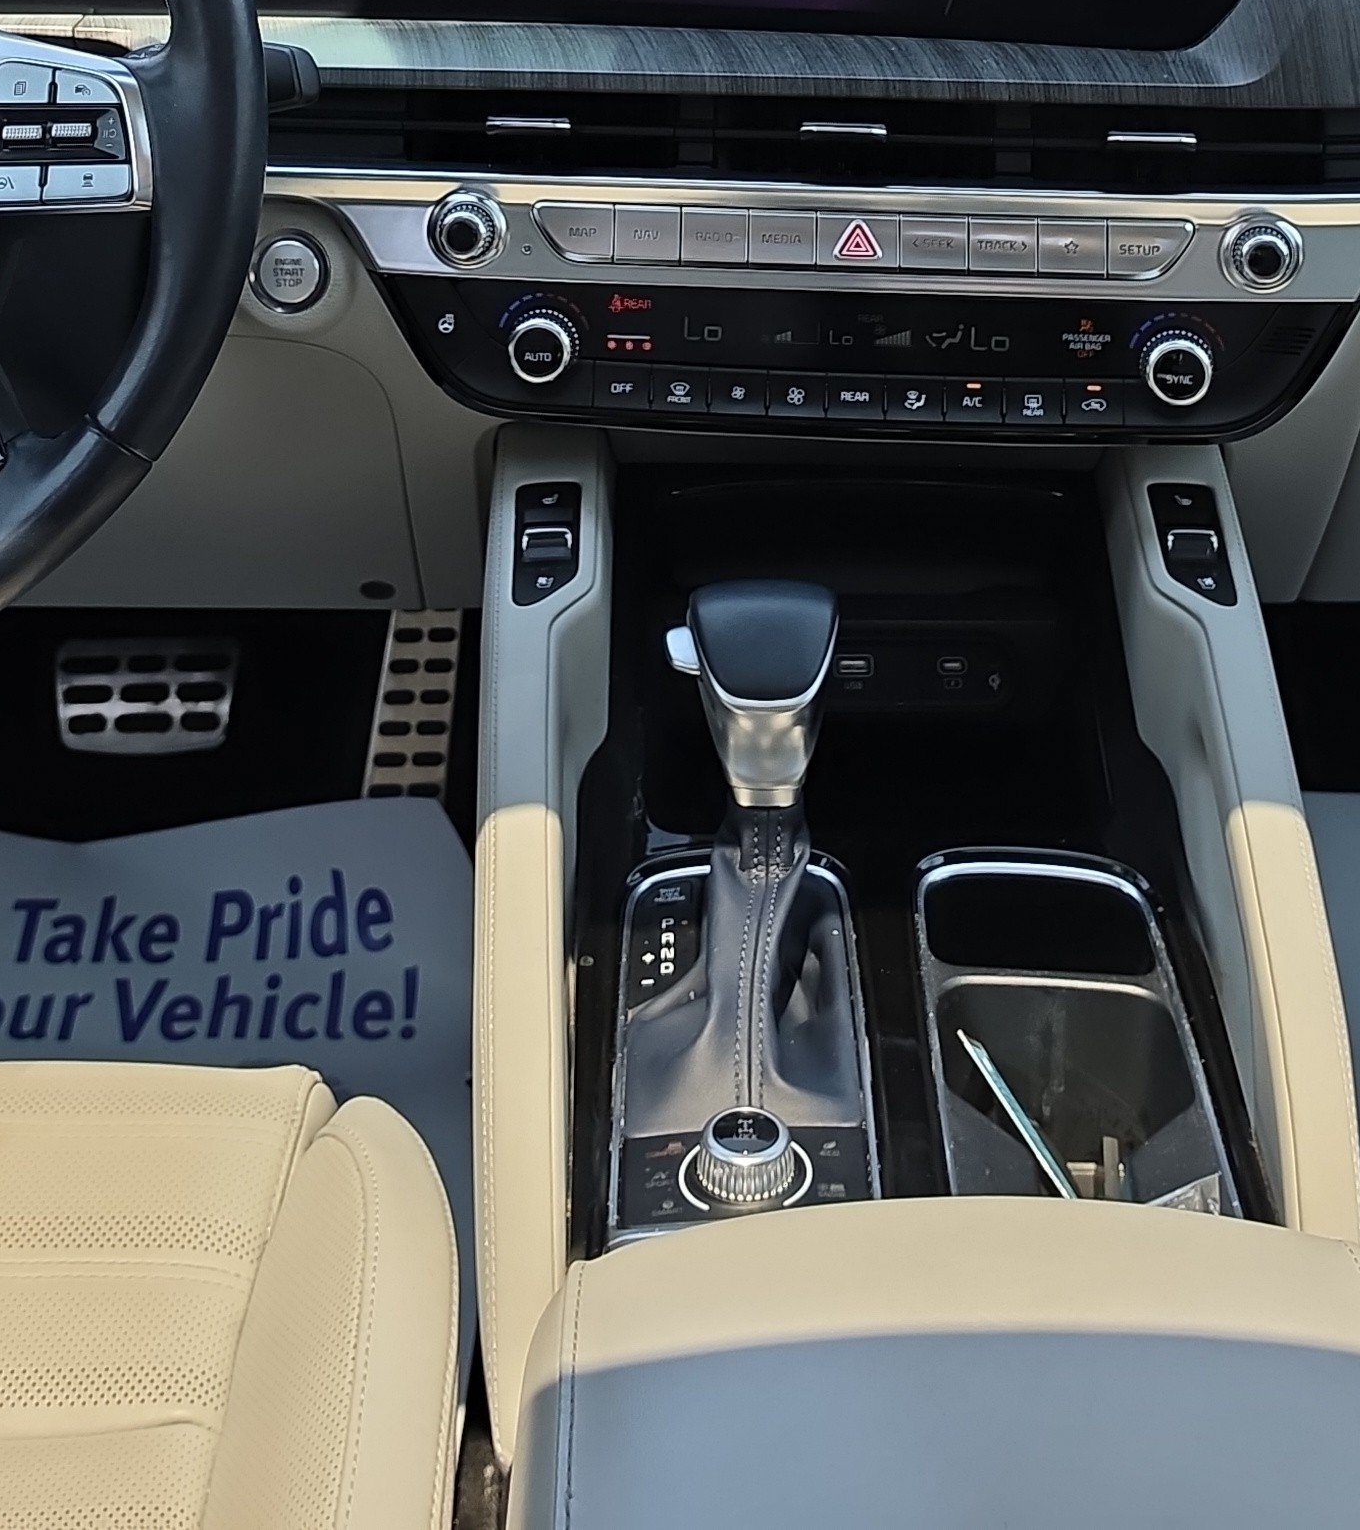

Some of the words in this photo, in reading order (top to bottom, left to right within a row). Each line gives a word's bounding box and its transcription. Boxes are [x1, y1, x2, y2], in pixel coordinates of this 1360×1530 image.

[569, 227, 597, 239] MAP
[633, 228, 660, 241] NAV
[762, 233, 802, 245] MEDIA
[976, 240, 1018, 251] TRACK
[1119, 244, 1160, 256] SETUP
[274, 258, 303, 266] ENGINE
[273, 267, 305, 277] START
[276, 278, 303, 288] STOP
[624, 298, 652, 310] REAR
[684, 317, 723, 342] Lo
[829, 330, 853, 346] Lo
[971, 326, 1010, 352] Lo
[1062, 332, 1111, 343] PASSENGER
[1069, 342, 1083, 350] AIR
[1085, 342, 1102, 351] BAG
[524, 352, 552, 362] AUTO
[1166, 374, 1193, 385] SYNC
[610, 382, 634, 394] OFF
[667, 395, 692, 404] FRONT
[840, 391, 869, 402] REAR
[962, 397, 983, 408] A/C
[1022, 409, 1044, 417] REAR
[12, 894, 182, 965] Take
[205, 868, 395, 964] Pride
[114, 965, 421, 1043] Vehicle!
